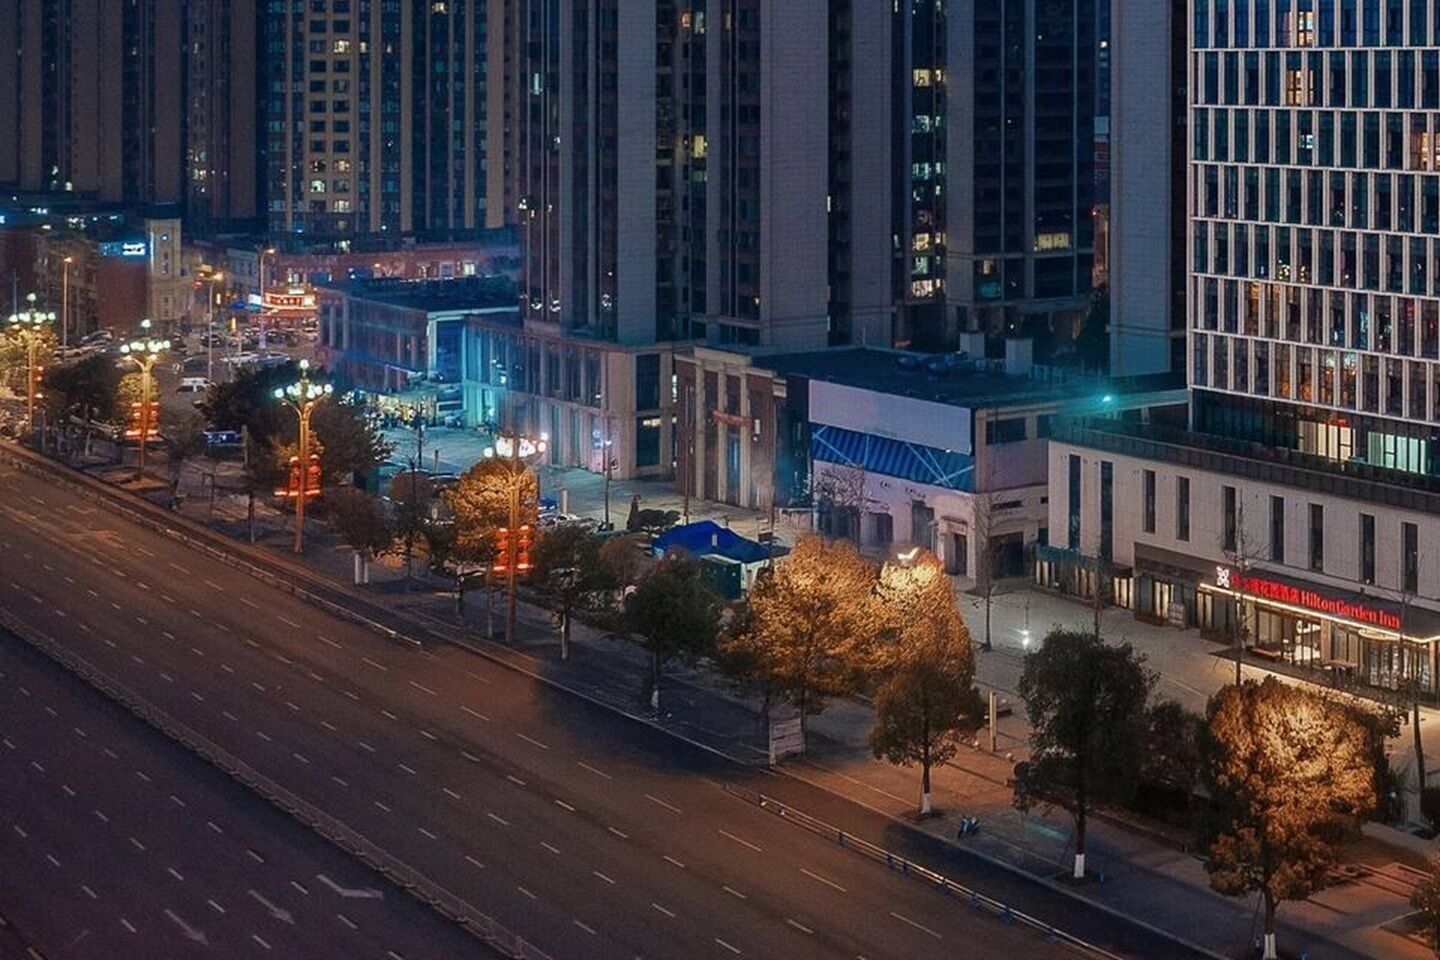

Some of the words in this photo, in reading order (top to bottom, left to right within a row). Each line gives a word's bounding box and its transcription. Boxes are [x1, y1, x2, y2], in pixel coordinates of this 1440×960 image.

[1230, 572, 1299, 604] 花园酒店
[1379, 609, 1400, 628] Inn
